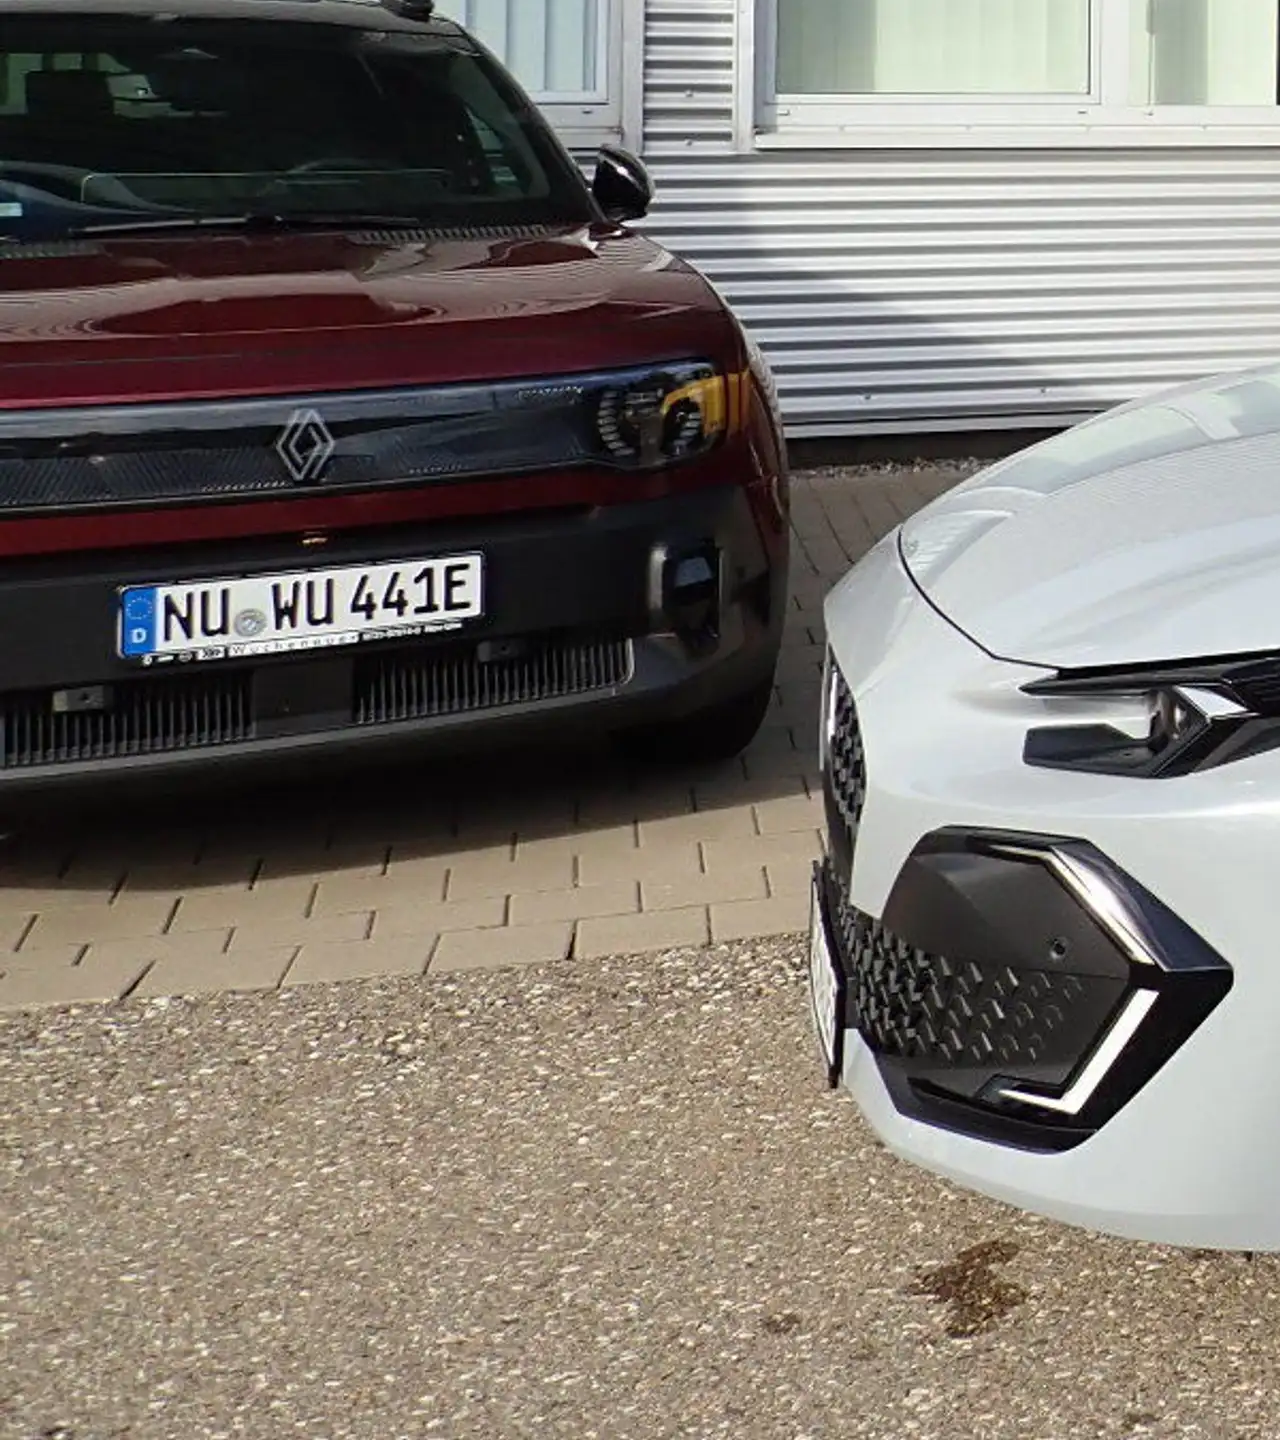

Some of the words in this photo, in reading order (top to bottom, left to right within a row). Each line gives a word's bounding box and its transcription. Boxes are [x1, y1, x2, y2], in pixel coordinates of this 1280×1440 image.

[162, 588, 230, 642] NU
[271, 578, 334, 631] WU
[349, 563, 471, 619] 441E
[132, 628, 148, 644] D
